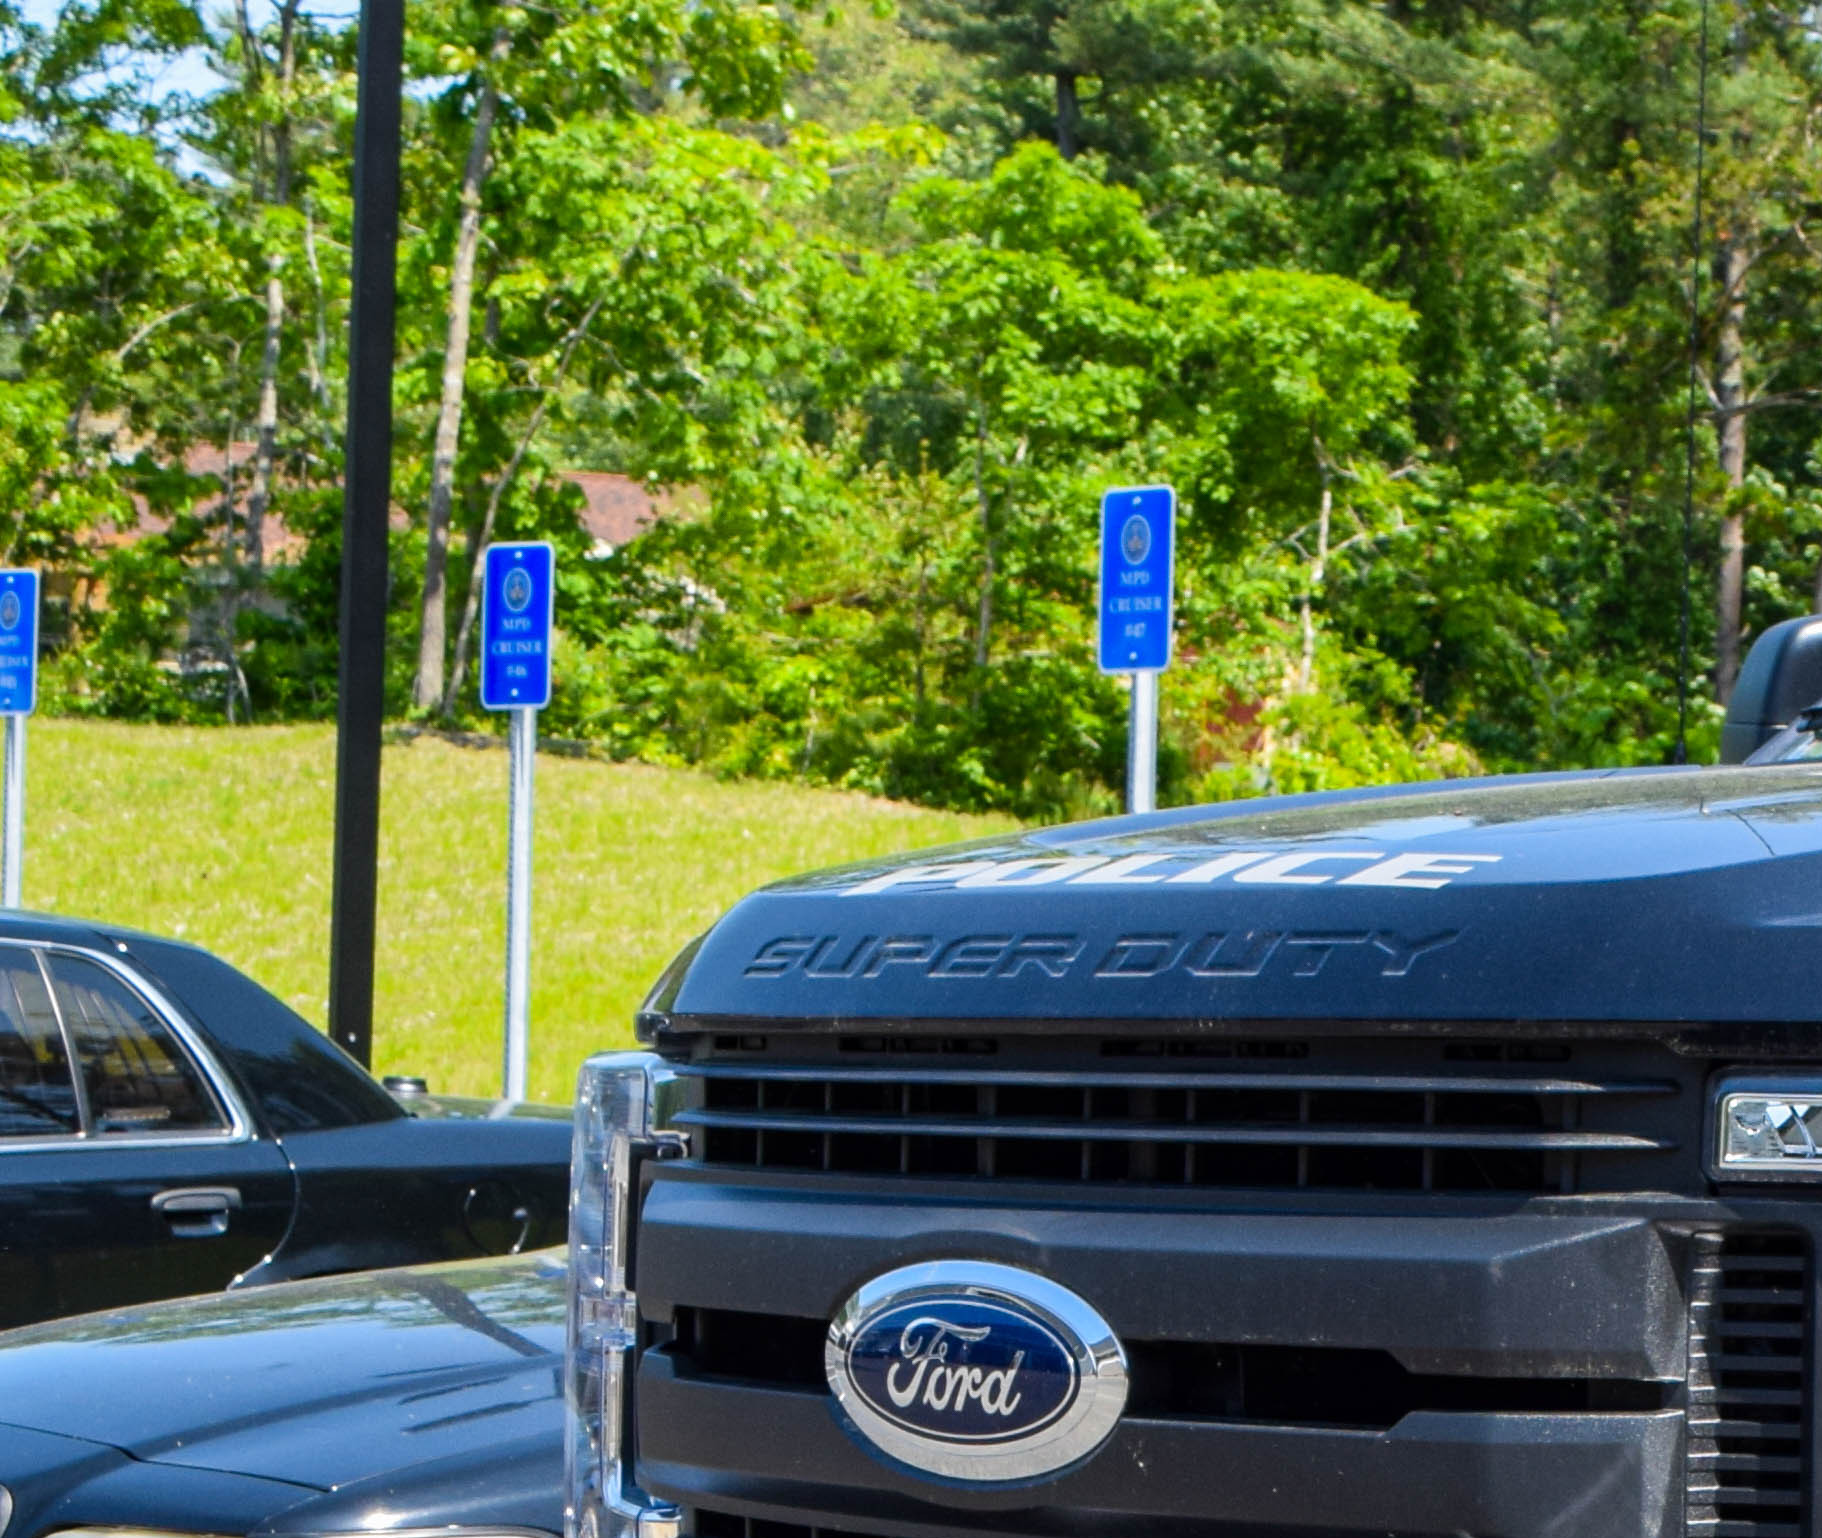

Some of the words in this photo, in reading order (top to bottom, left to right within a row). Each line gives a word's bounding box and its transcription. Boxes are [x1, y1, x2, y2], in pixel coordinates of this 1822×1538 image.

[841, 851, 1502, 897] POLICE
[743, 933, 1084, 979] SUPER
[1094, 927, 1464, 979] DUTY
[886, 1317, 1025, 1415] Ford
